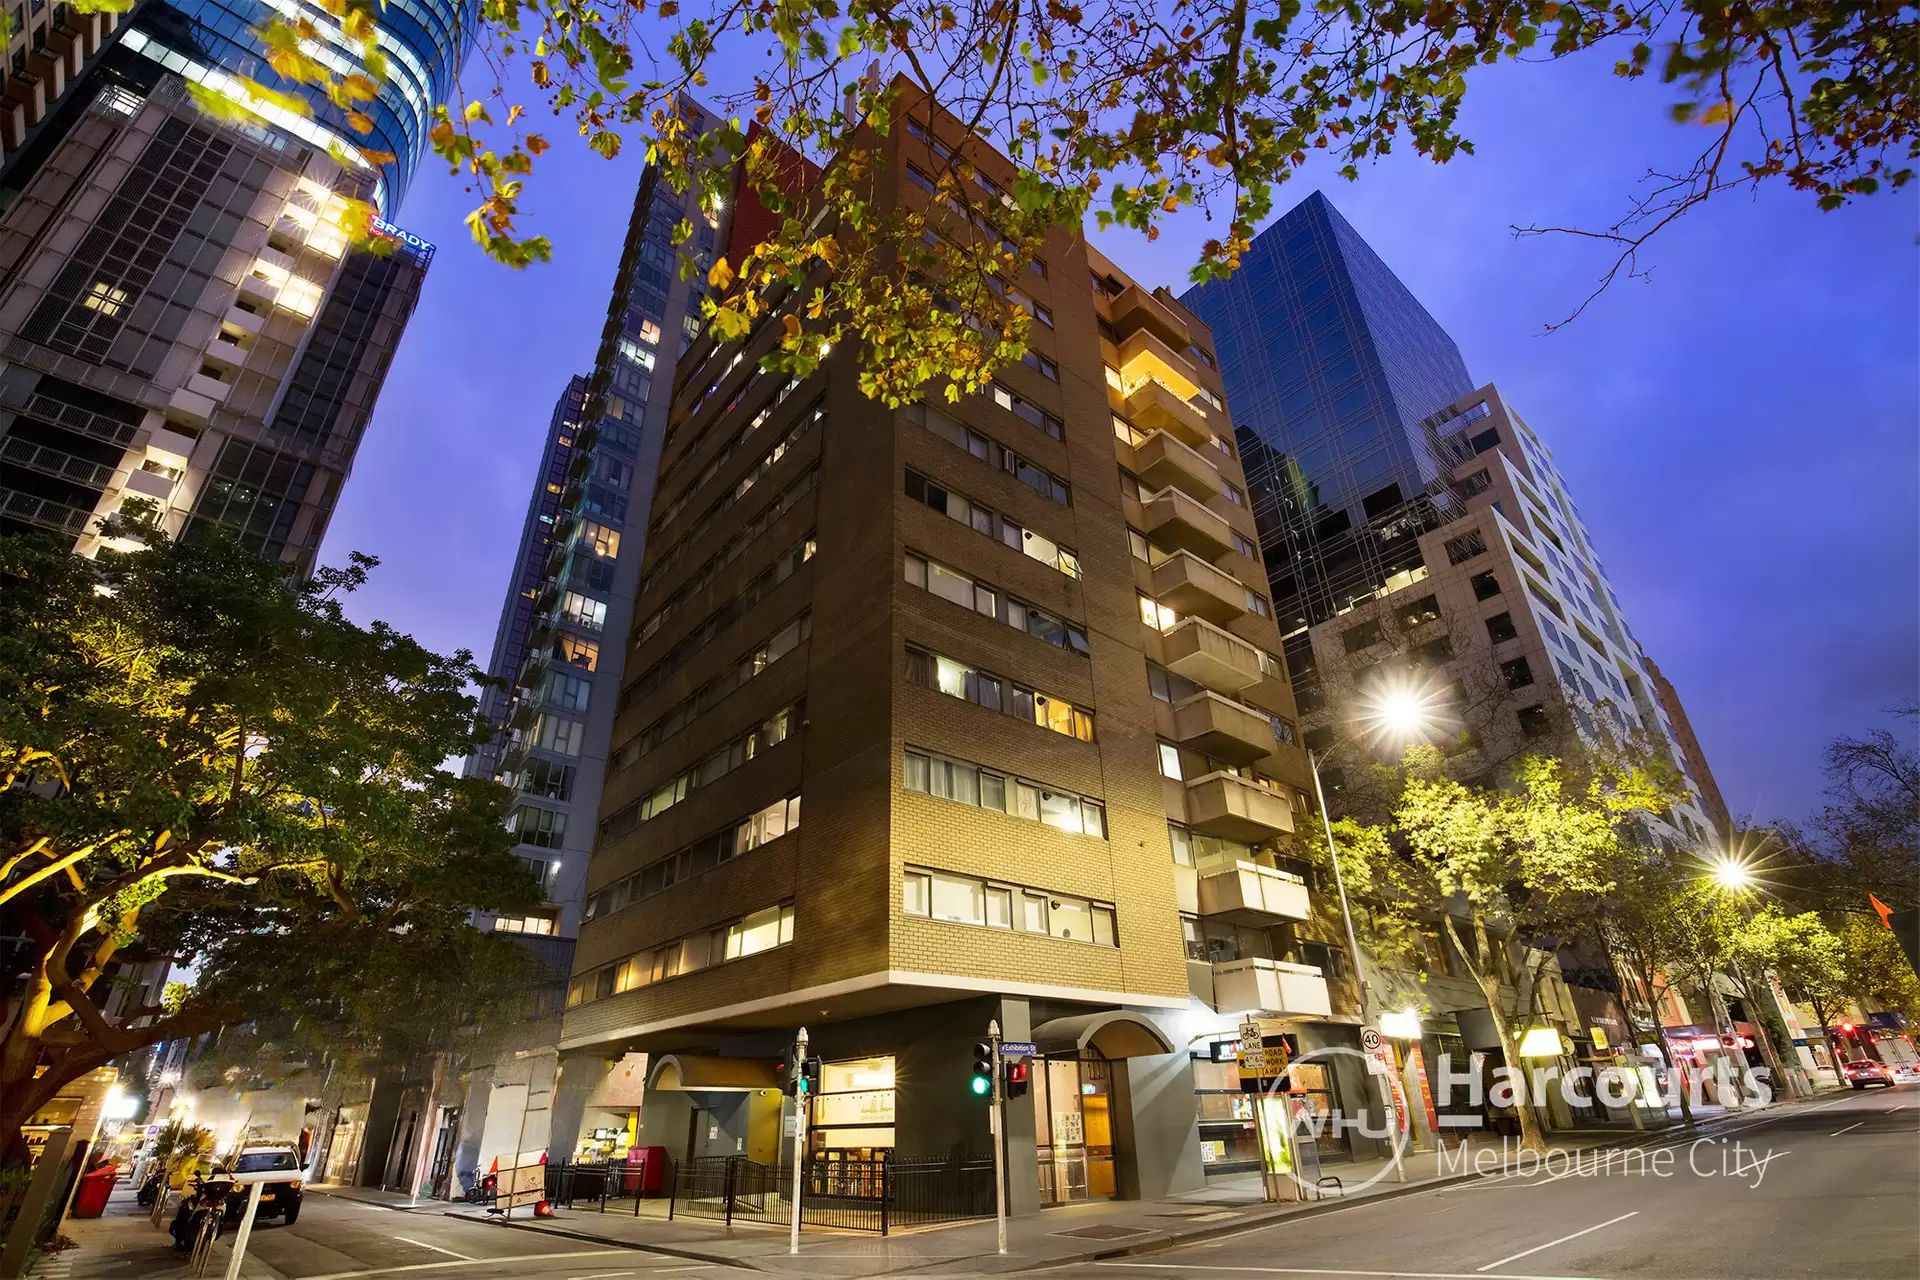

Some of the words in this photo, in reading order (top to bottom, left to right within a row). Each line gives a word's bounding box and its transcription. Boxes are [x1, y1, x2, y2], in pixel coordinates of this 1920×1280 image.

[373, 218, 431, 250] BRADY
[1365, 1034, 1379, 1045] 40
[1005, 1043, 1029, 1051] Exhibition
[1030, 1043, 1036, 1051] St
[1244, 1041, 1261, 1050] LANE
[1265, 1049, 1282, 1057] ROAD
[1266, 1058, 1285, 1066] WORK
[1265, 1066, 1289, 1076] AHEAD
